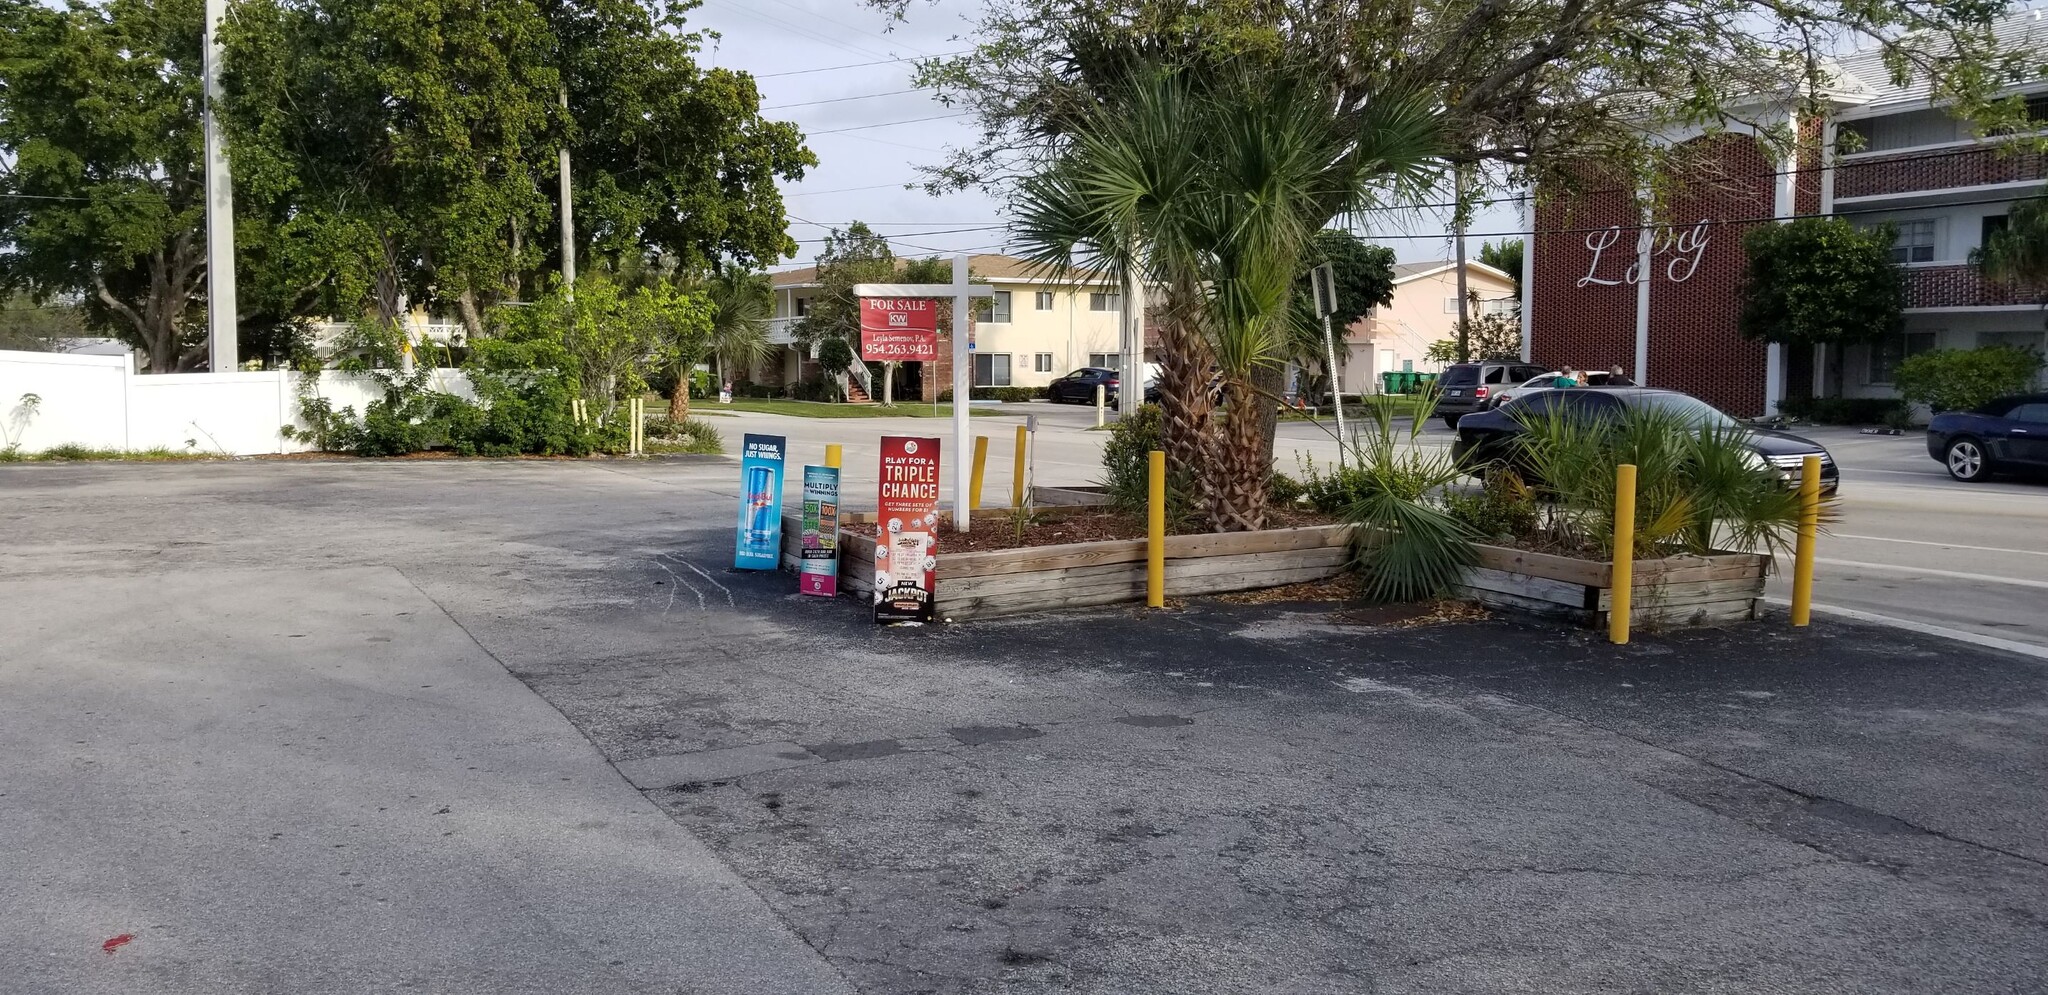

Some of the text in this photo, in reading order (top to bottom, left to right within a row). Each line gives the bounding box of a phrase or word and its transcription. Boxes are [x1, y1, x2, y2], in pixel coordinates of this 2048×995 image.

[870, 300, 926, 310] FOR SALE
[890, 314, 906, 322] KW
[866, 344, 934, 354] 954.263.9421
[886, 466, 934, 482] TRIPLE
[883, 483, 936, 499] CHANCE
[885, 588, 928, 603] JACKPOT
